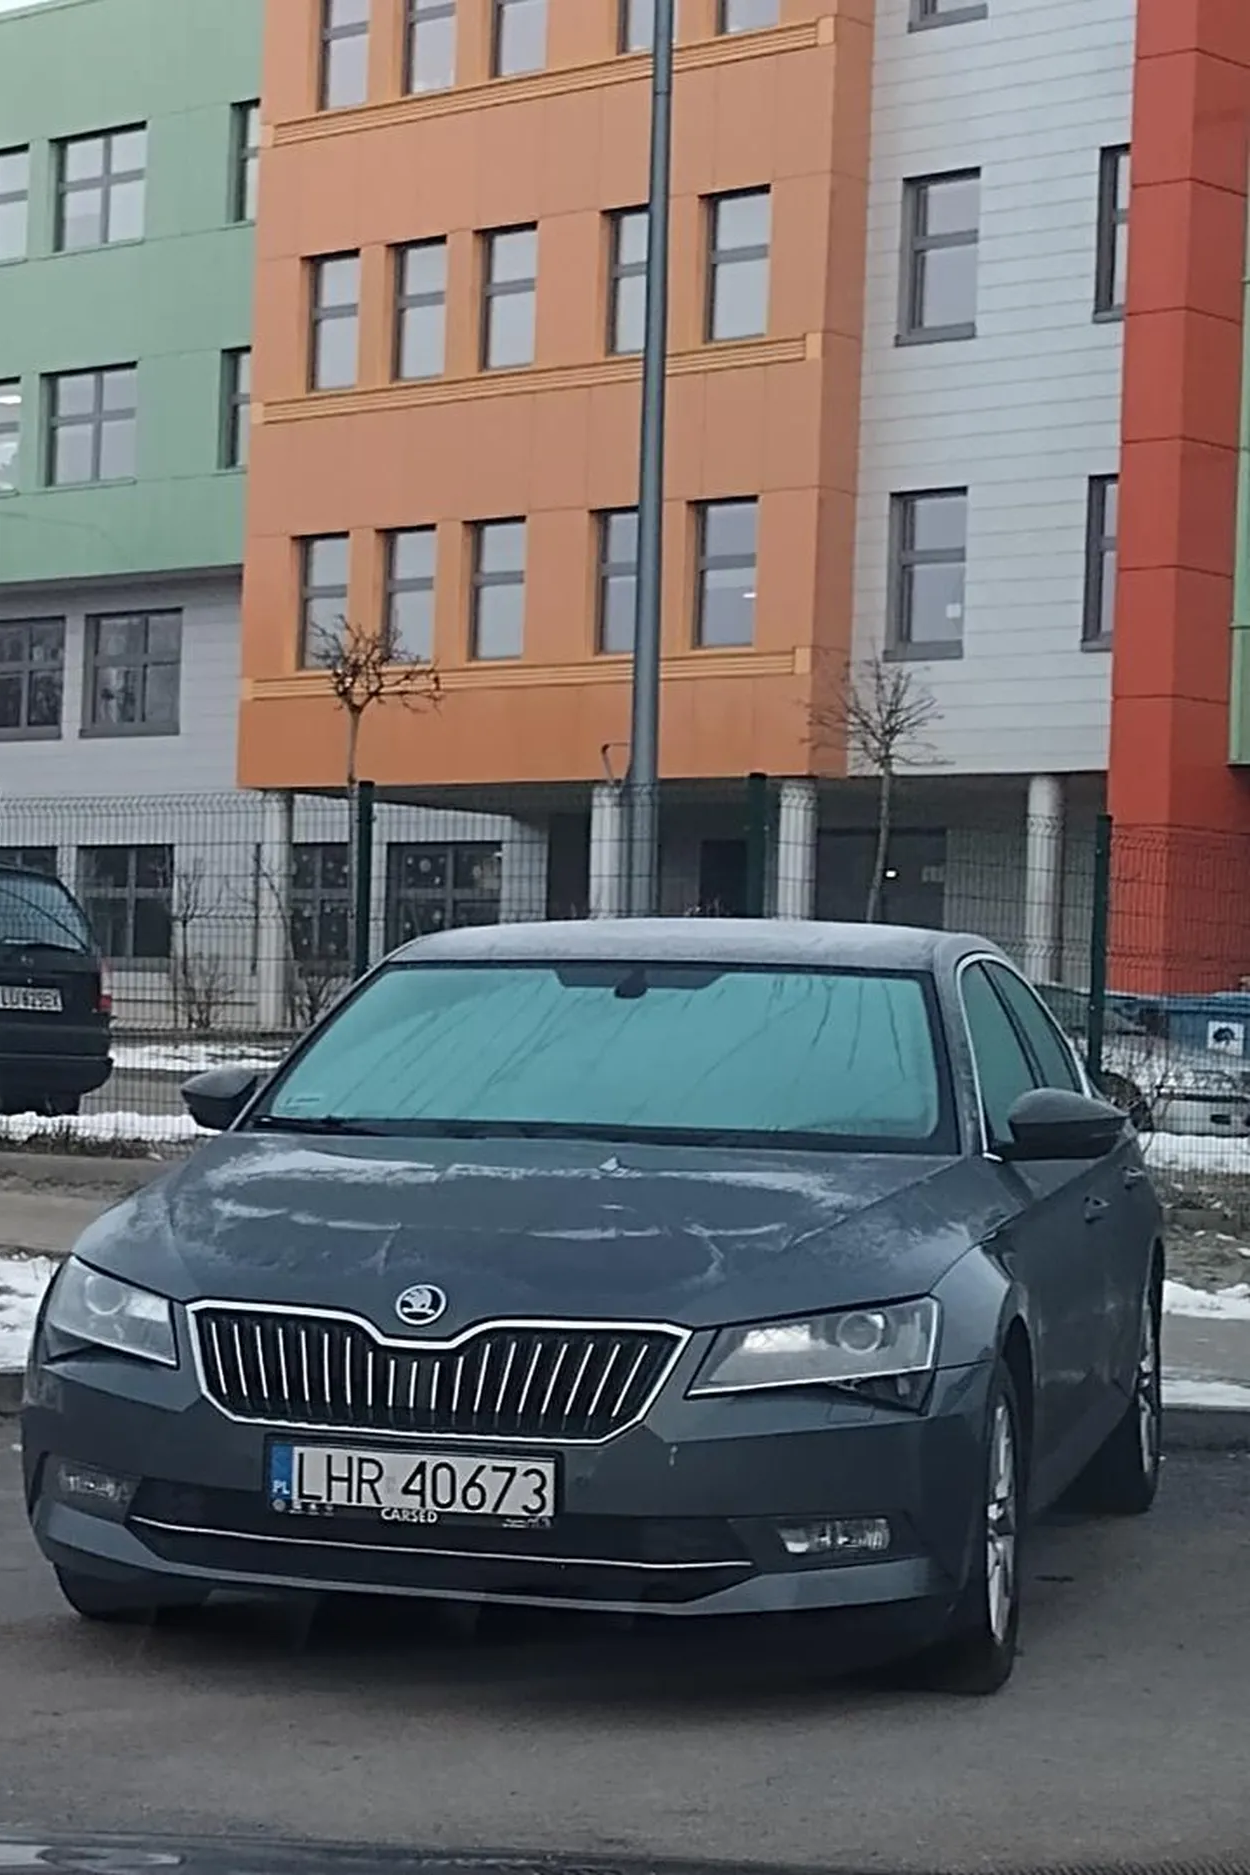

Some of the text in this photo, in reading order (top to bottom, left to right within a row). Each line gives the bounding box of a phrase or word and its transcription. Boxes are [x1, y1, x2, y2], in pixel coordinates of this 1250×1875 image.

[272, 1479, 290, 1495] PL
[297, 1452, 547, 1514] LHR 40673
[381, 1507, 438, 1524] CARSED
